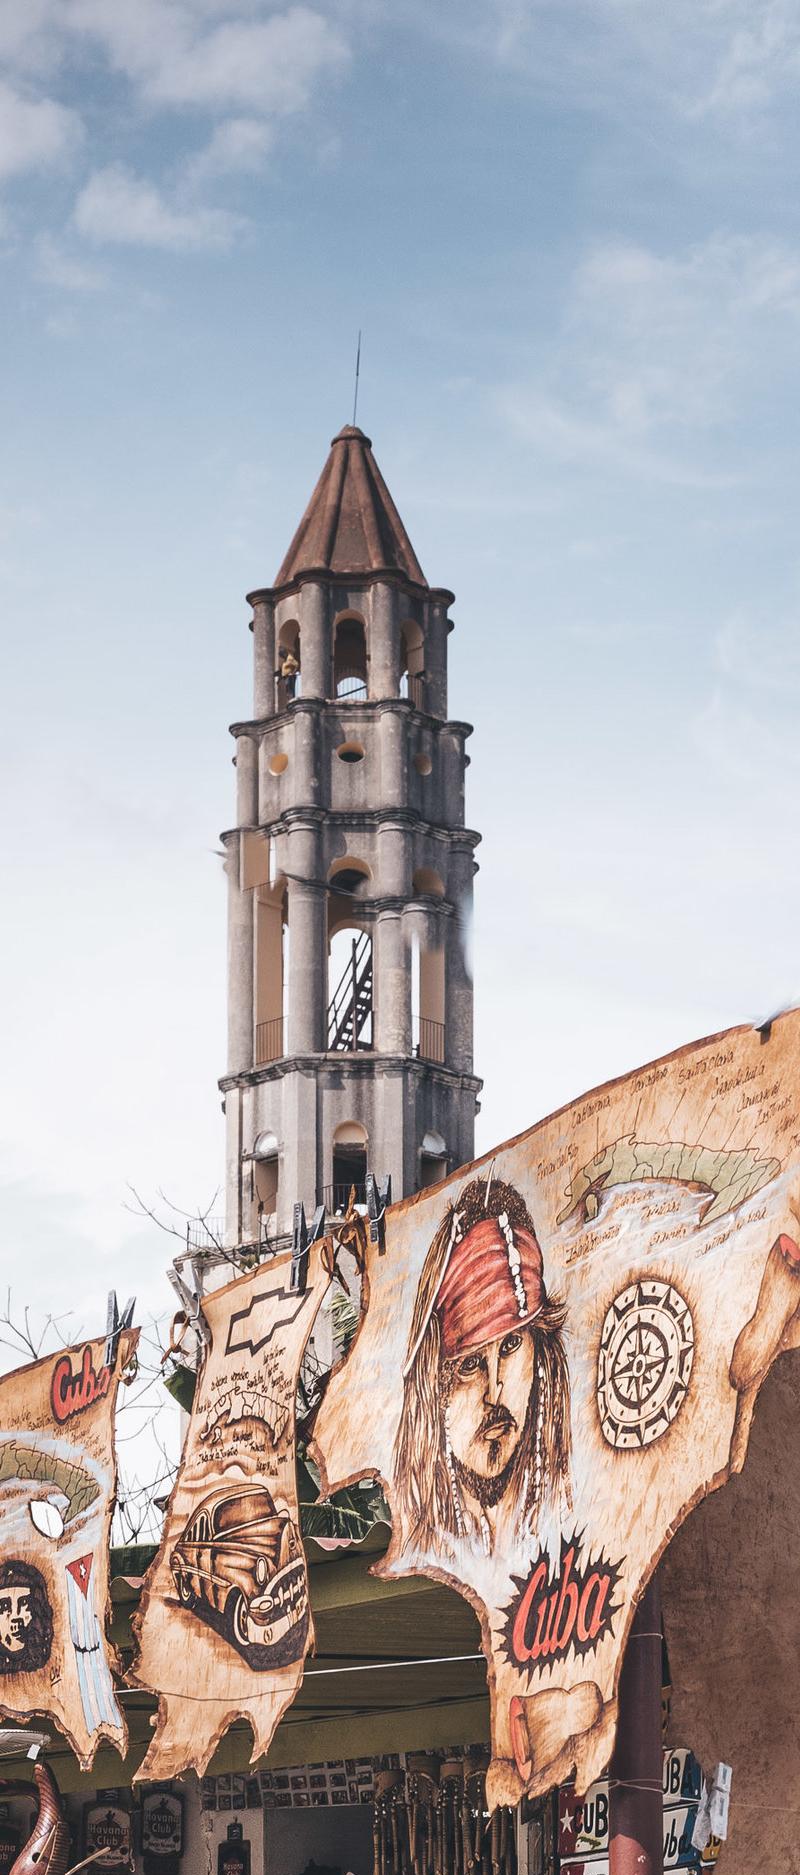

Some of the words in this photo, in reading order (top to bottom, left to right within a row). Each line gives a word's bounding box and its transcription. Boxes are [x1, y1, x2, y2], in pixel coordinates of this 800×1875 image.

[52, 1347, 112, 1423] Cuba
[512, 1546, 610, 1663] Cuba
[96, 1834, 119, 1846] Club
[573, 1793, 609, 1838] CUB
